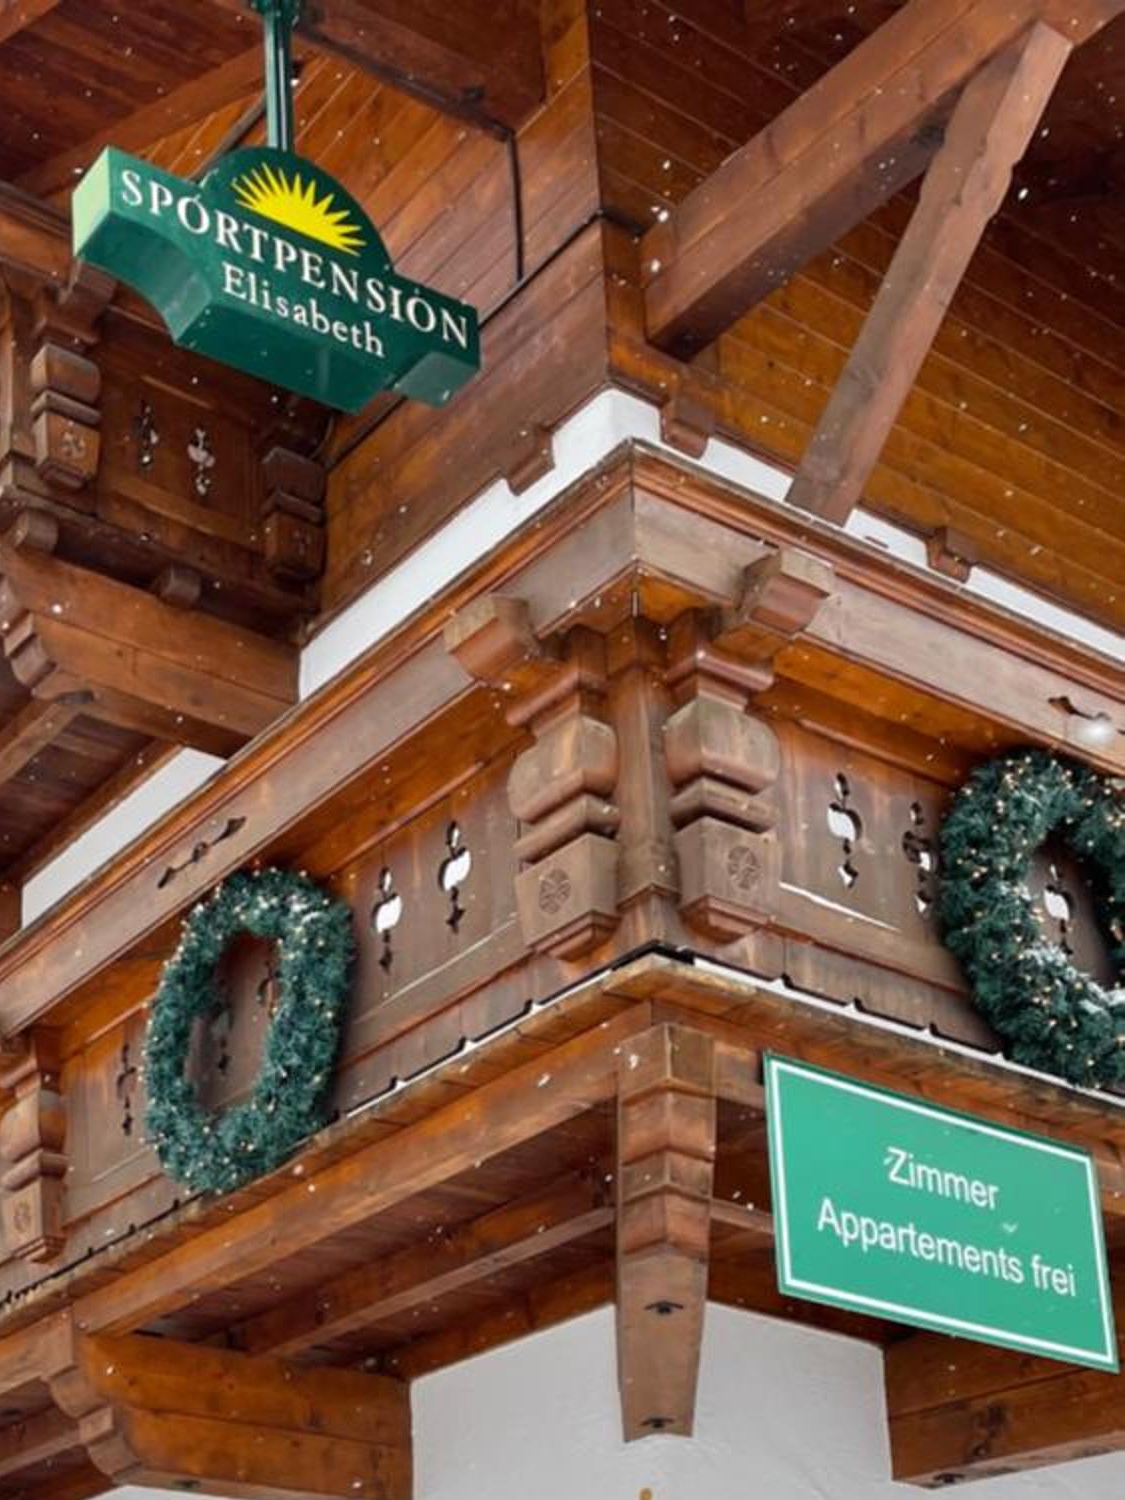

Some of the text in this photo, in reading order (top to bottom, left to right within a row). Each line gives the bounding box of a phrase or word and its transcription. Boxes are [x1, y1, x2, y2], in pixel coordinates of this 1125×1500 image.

[120, 169, 468, 350] SPORTPENSION
[221, 261, 386, 359] Elisabeth
[887, 1146, 1000, 1211] Zimmer
[817, 1196, 1077, 1297] Appartements frei
